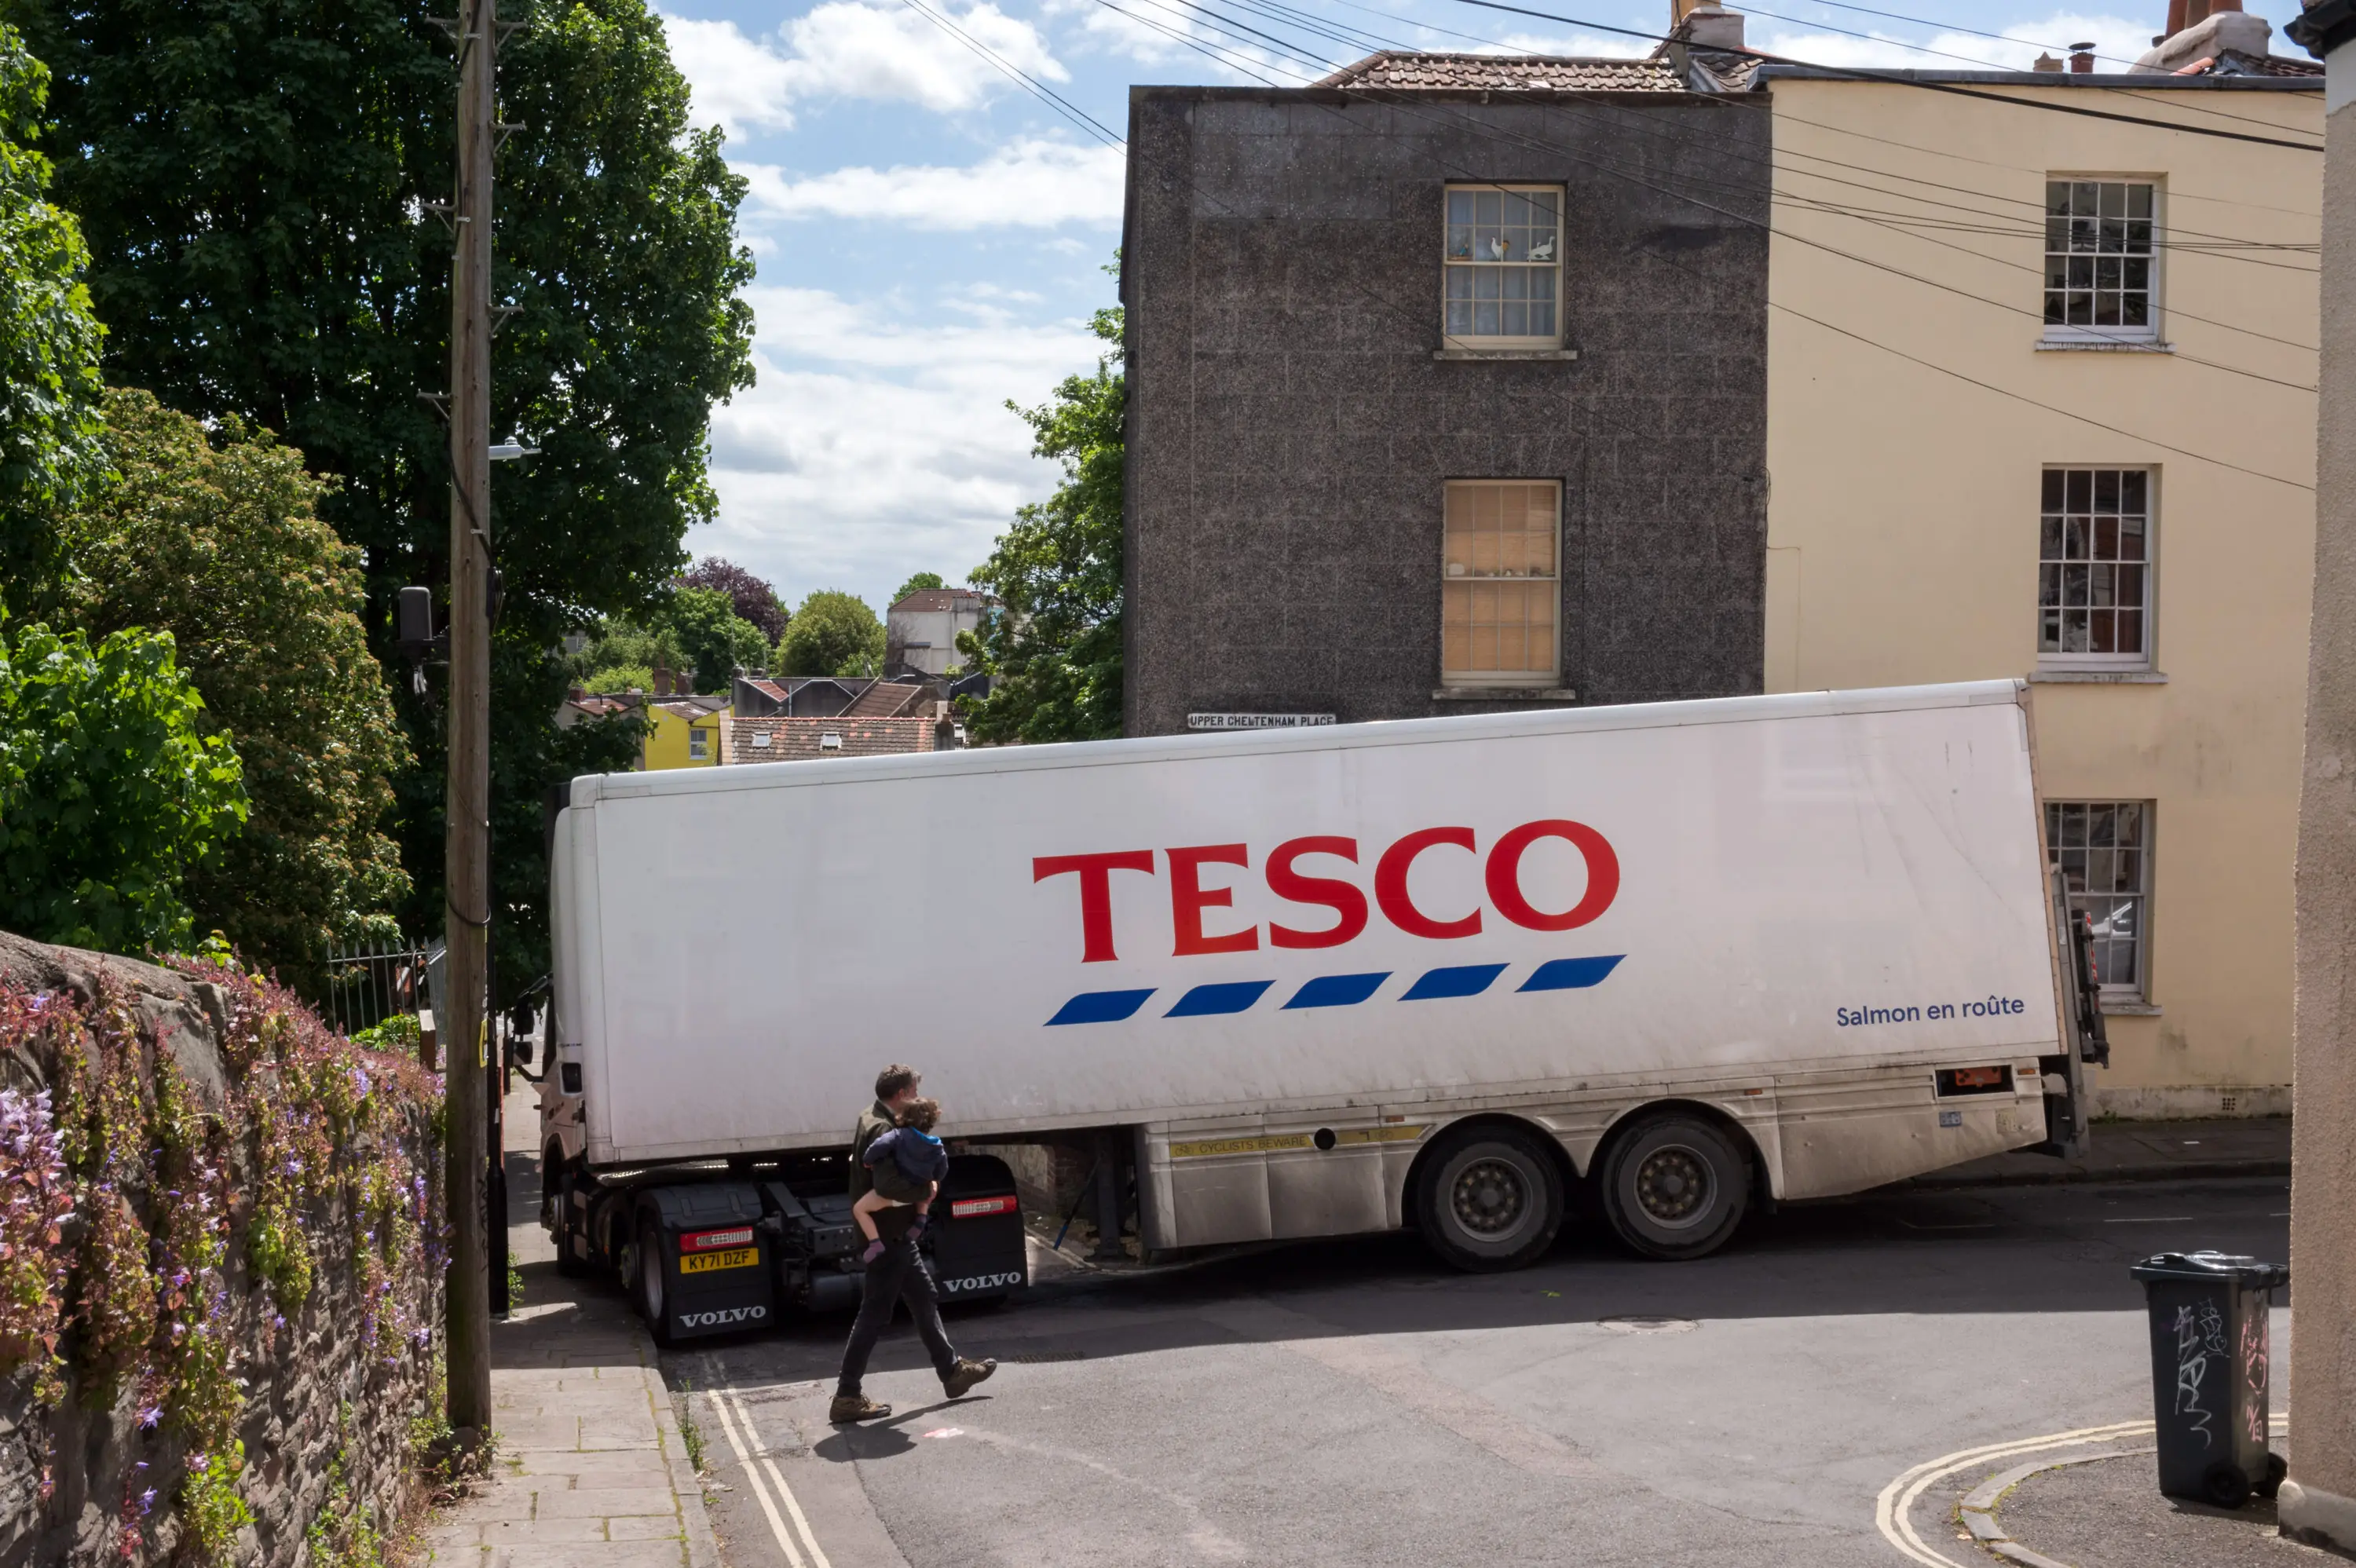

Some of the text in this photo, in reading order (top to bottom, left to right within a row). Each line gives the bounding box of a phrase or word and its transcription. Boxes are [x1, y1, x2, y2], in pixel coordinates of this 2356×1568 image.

[1191, 715, 1333, 726] UPPER CHELTENHAM PLACE
[1033, 819, 1620, 963] TESCO
[1836, 995, 2025, 1027] Salmon en roûte
[1199, 1136, 1307, 1153] CYCLISTS BEWARE
[689, 1250, 750, 1270] KY71 DZF
[944, 1271, 1022, 1292] VOLVO
[679, 1305, 766, 1328] VOLVO
